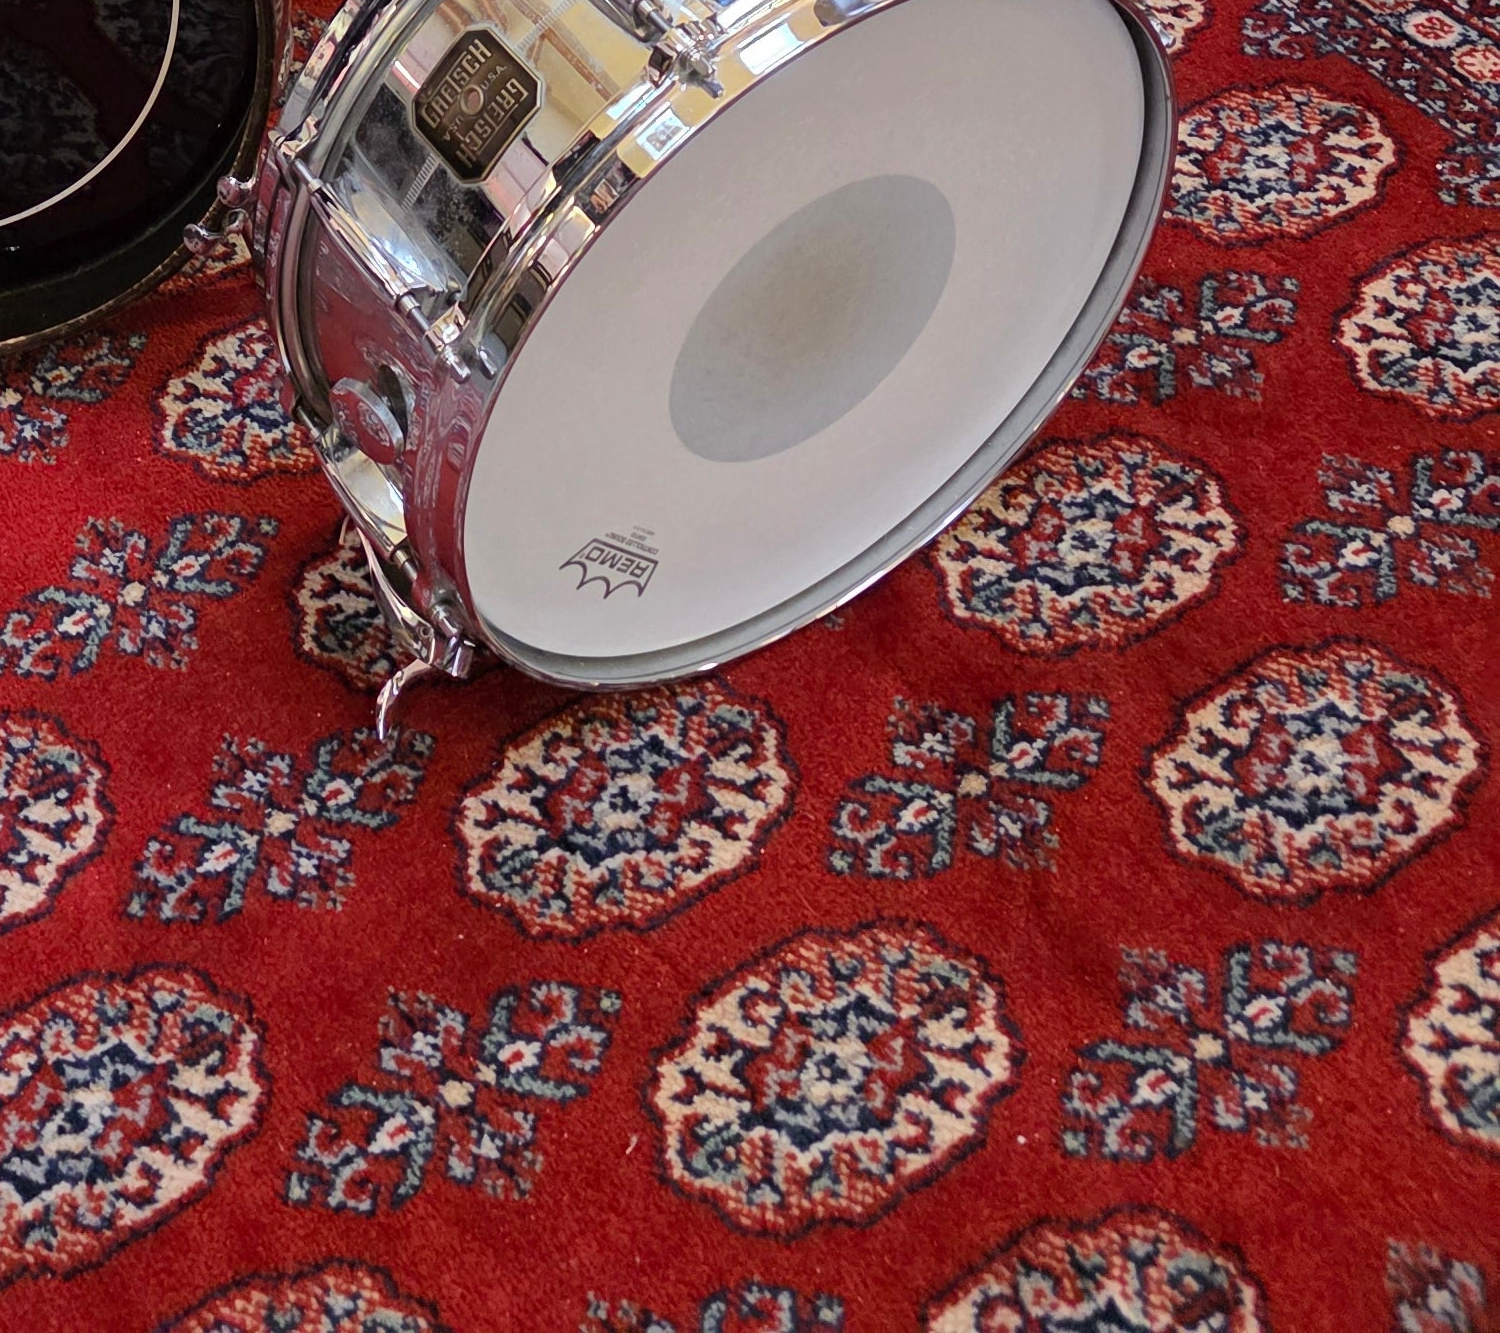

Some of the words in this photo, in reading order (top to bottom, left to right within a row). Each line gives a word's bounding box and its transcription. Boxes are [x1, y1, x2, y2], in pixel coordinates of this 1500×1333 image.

[421, 39, 492, 129] GRETSCH
[456, 78, 529, 168] GRETSCH
[585, 545, 650, 579] REMO
